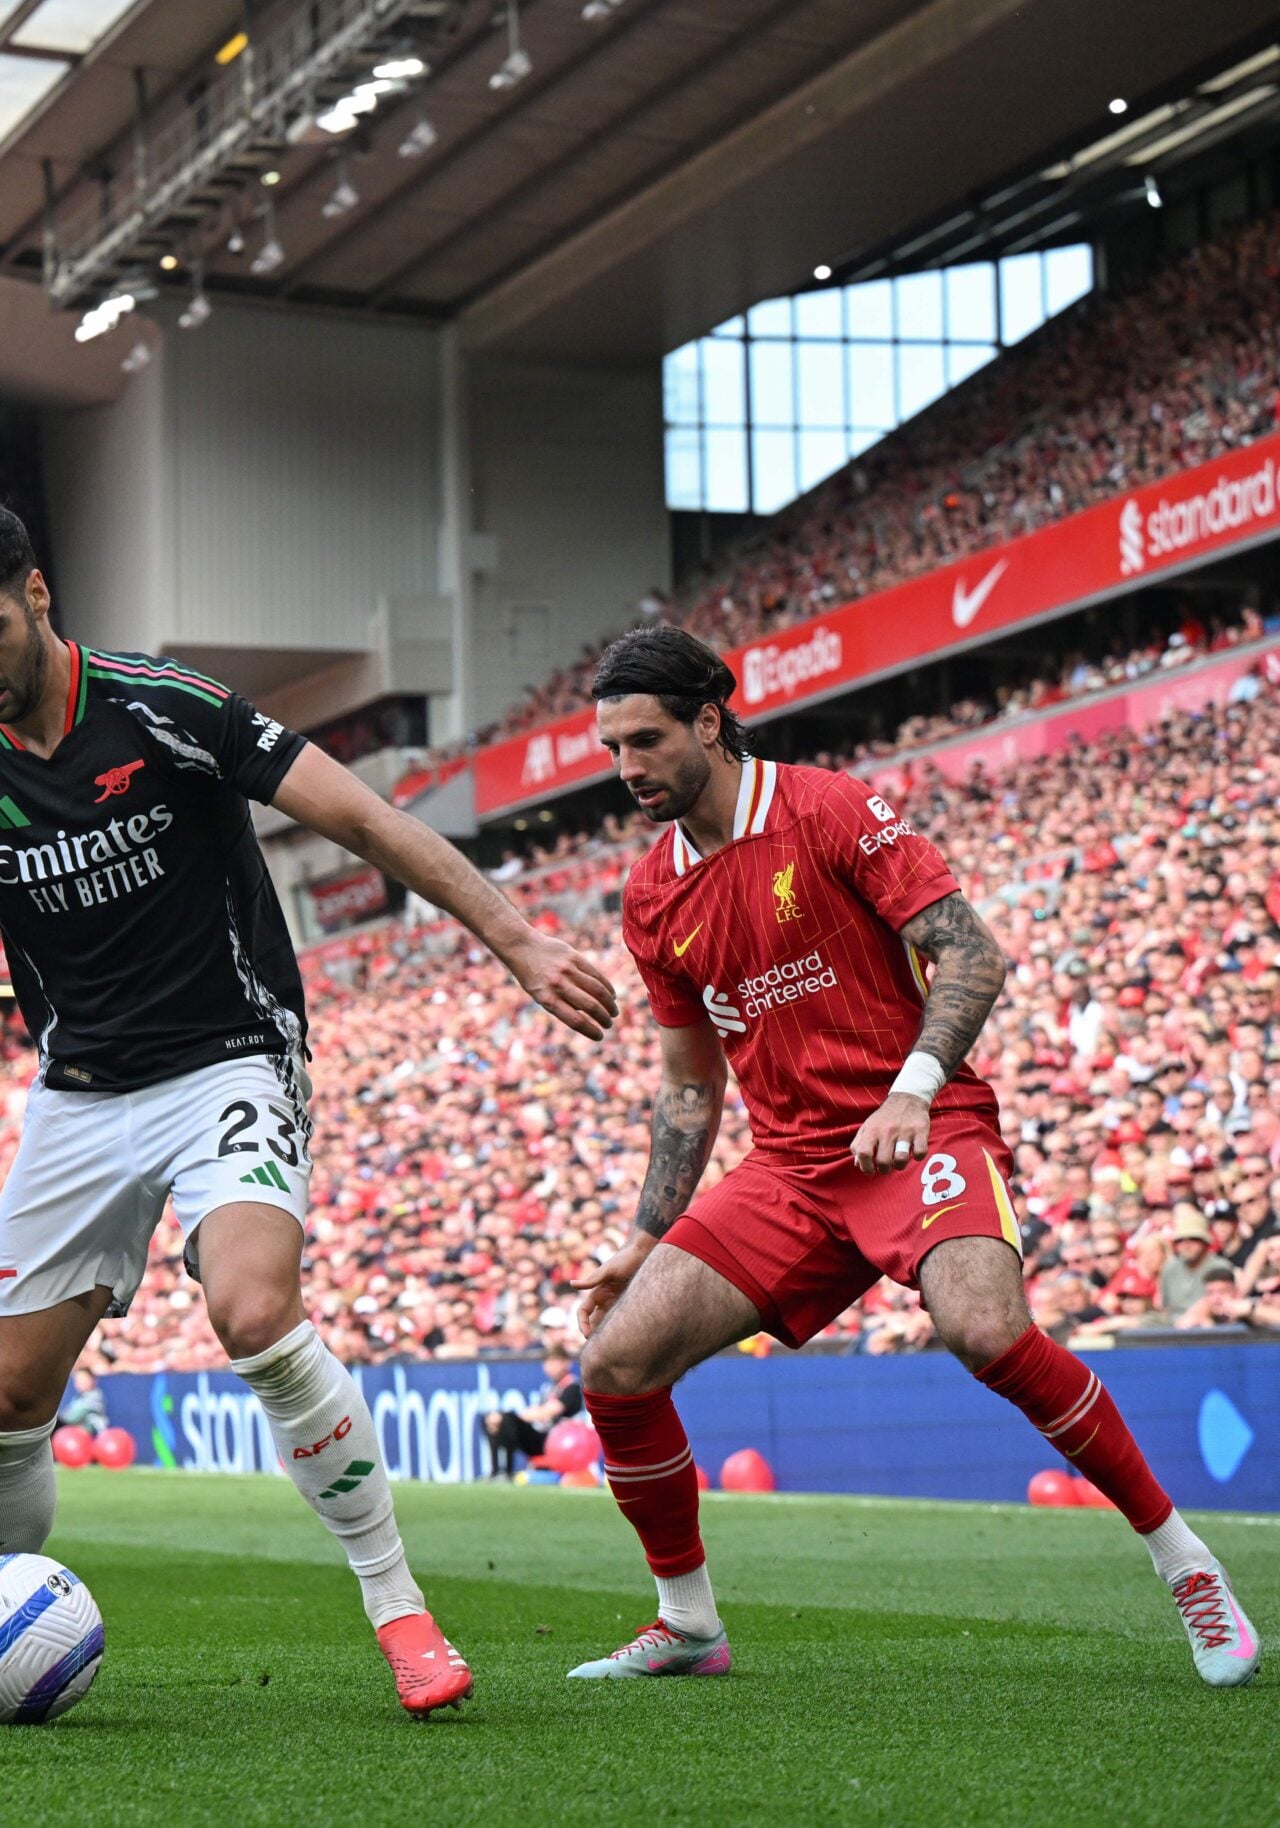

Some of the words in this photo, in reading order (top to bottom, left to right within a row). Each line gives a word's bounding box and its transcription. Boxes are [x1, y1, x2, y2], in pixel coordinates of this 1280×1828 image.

[1147, 459, 1275, 557] standard
[858, 819, 916, 855] Exped
[28, 883, 70, 913] FLY
[74, 847, 165, 908] BETTER
[225, 1034, 264, 1049] HEAT.RDY
[218, 1100, 300, 1168] 23
[921, 1153, 966, 1206] 8
[293, 1415, 353, 1460] AFC
